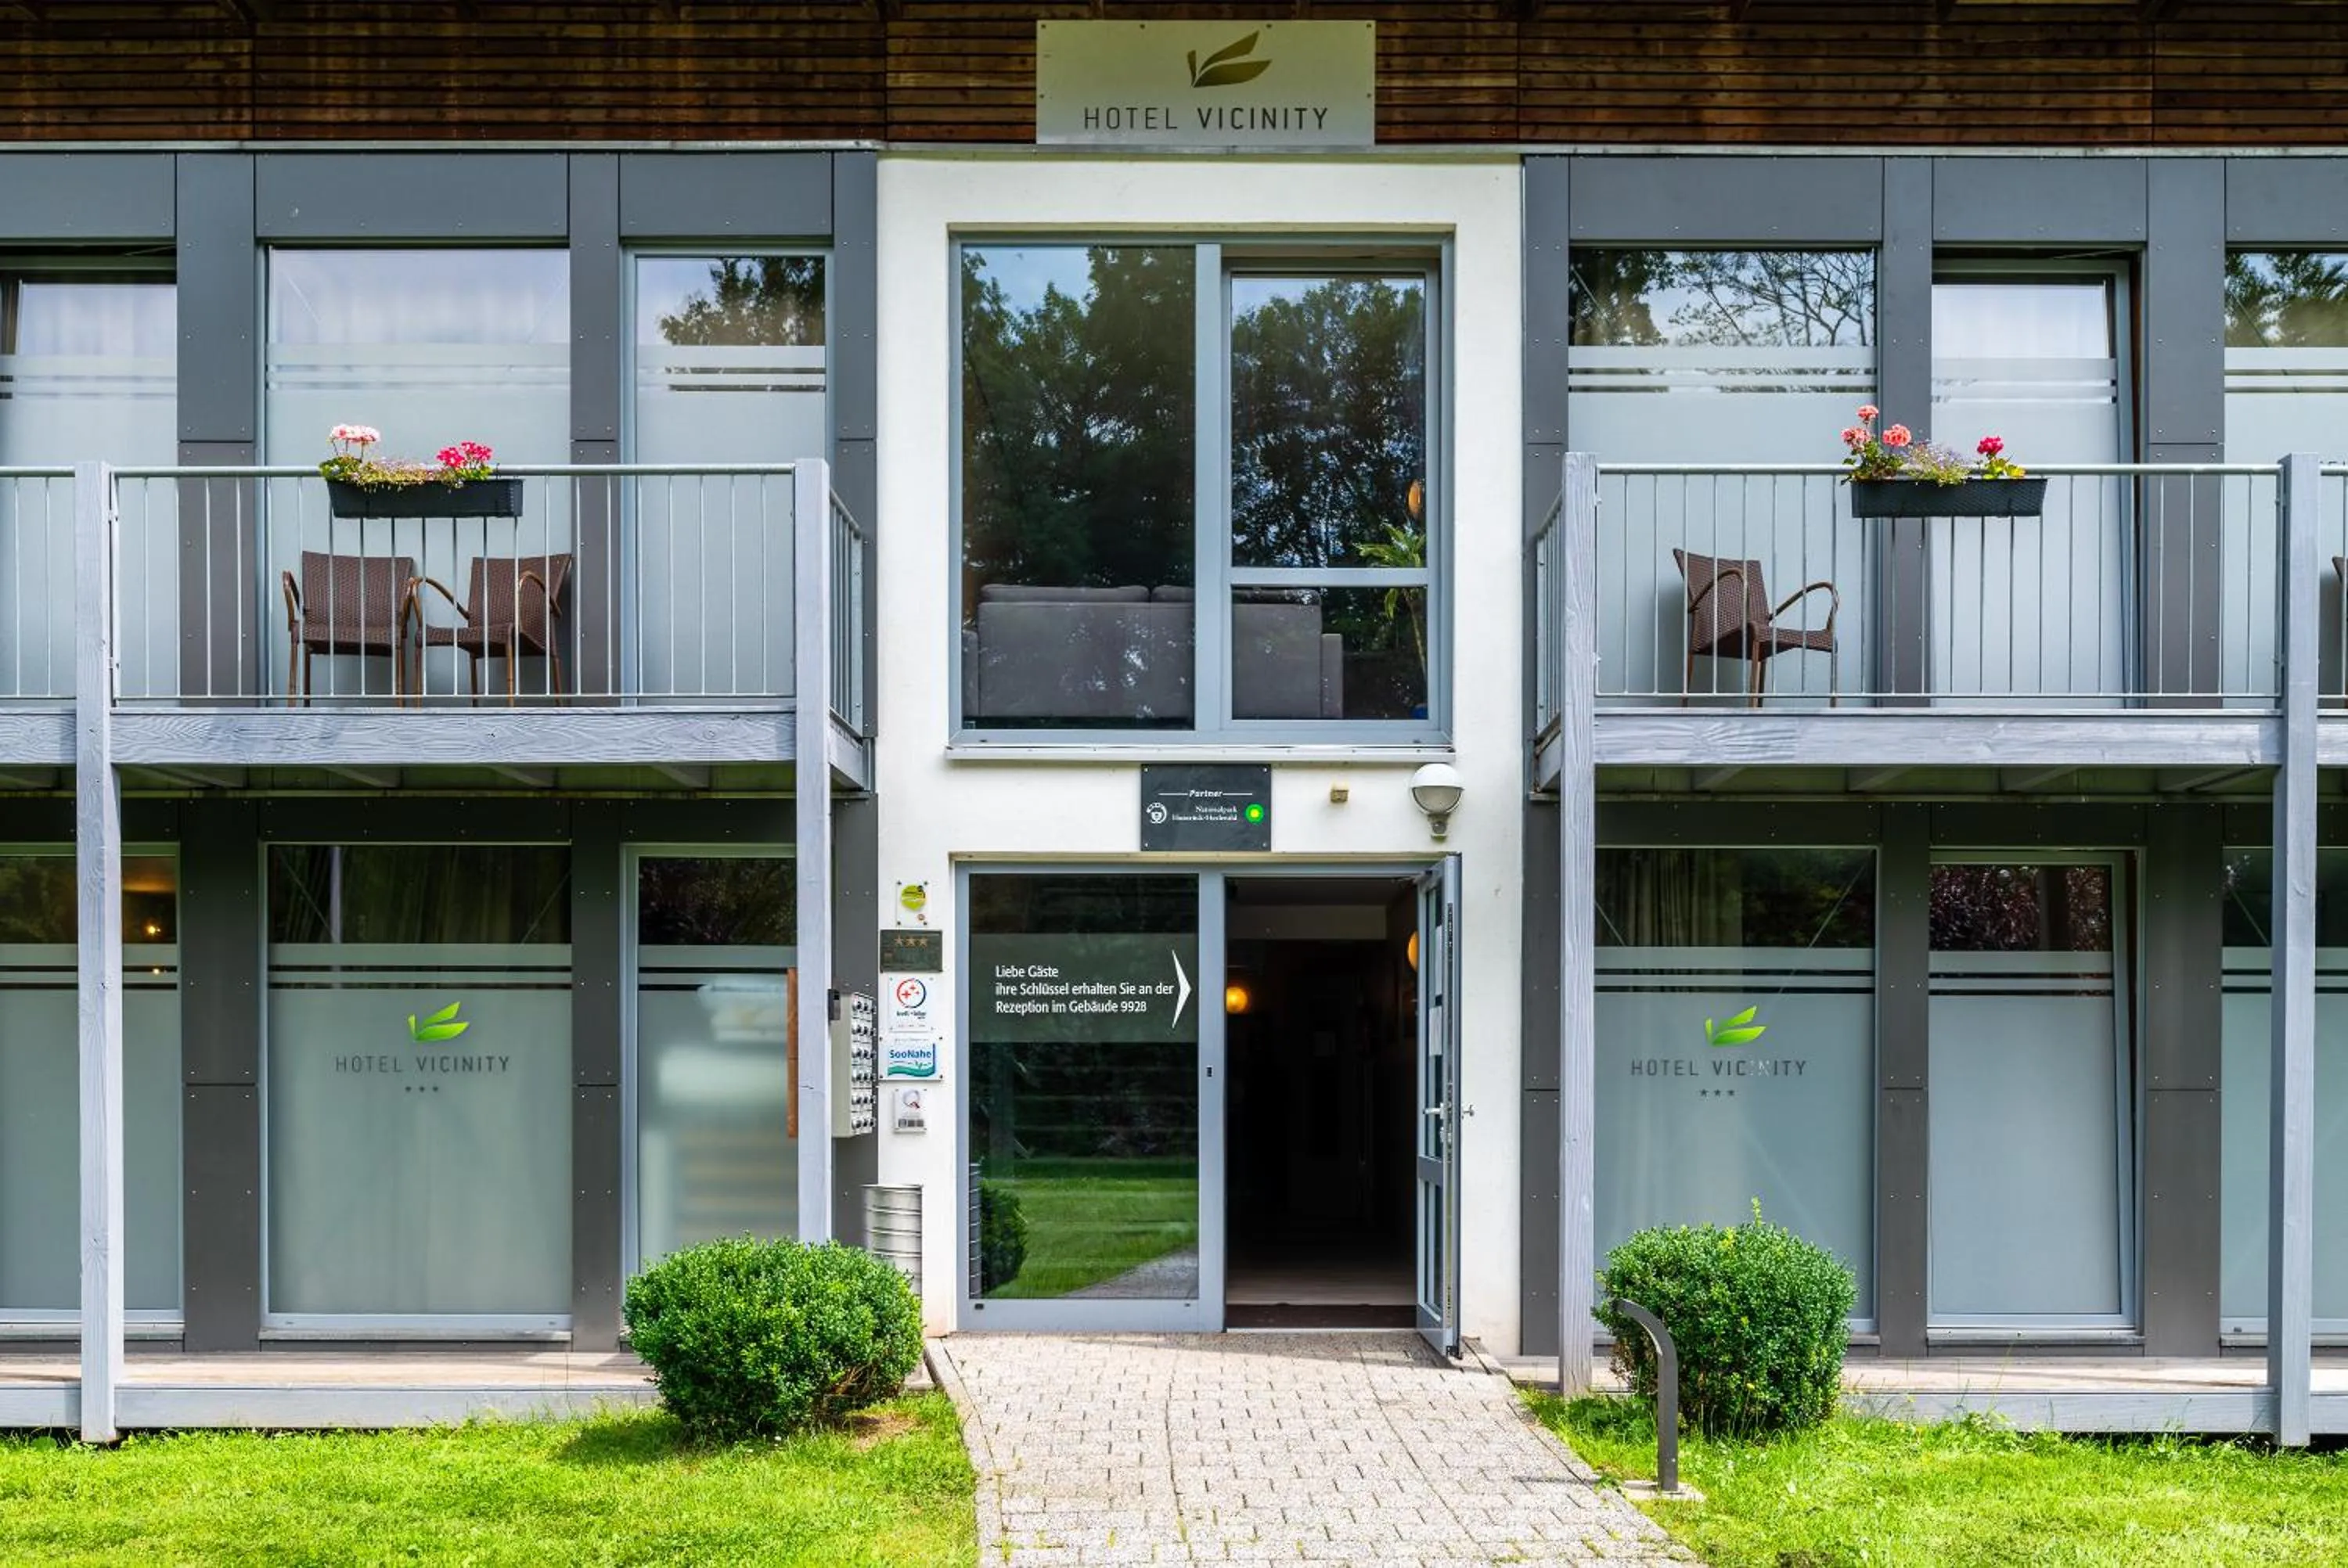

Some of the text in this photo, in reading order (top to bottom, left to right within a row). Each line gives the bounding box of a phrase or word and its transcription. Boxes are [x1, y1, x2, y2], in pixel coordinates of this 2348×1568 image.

[1084, 106, 1329, 130] HOTEL VICINITY
[996, 965, 1059, 977] Liebe Gäste
[996, 983, 1175, 995] ihre Schlüssel erhalten Sie an der
[996, 1001, 1147, 1016] Rezeption im Gebäude 9928
[889, 1049, 932, 1059] SooNahe
[335, 1056, 510, 1073] HOTEL VICINITY
[1631, 1060, 1699, 1077] HOTEL
